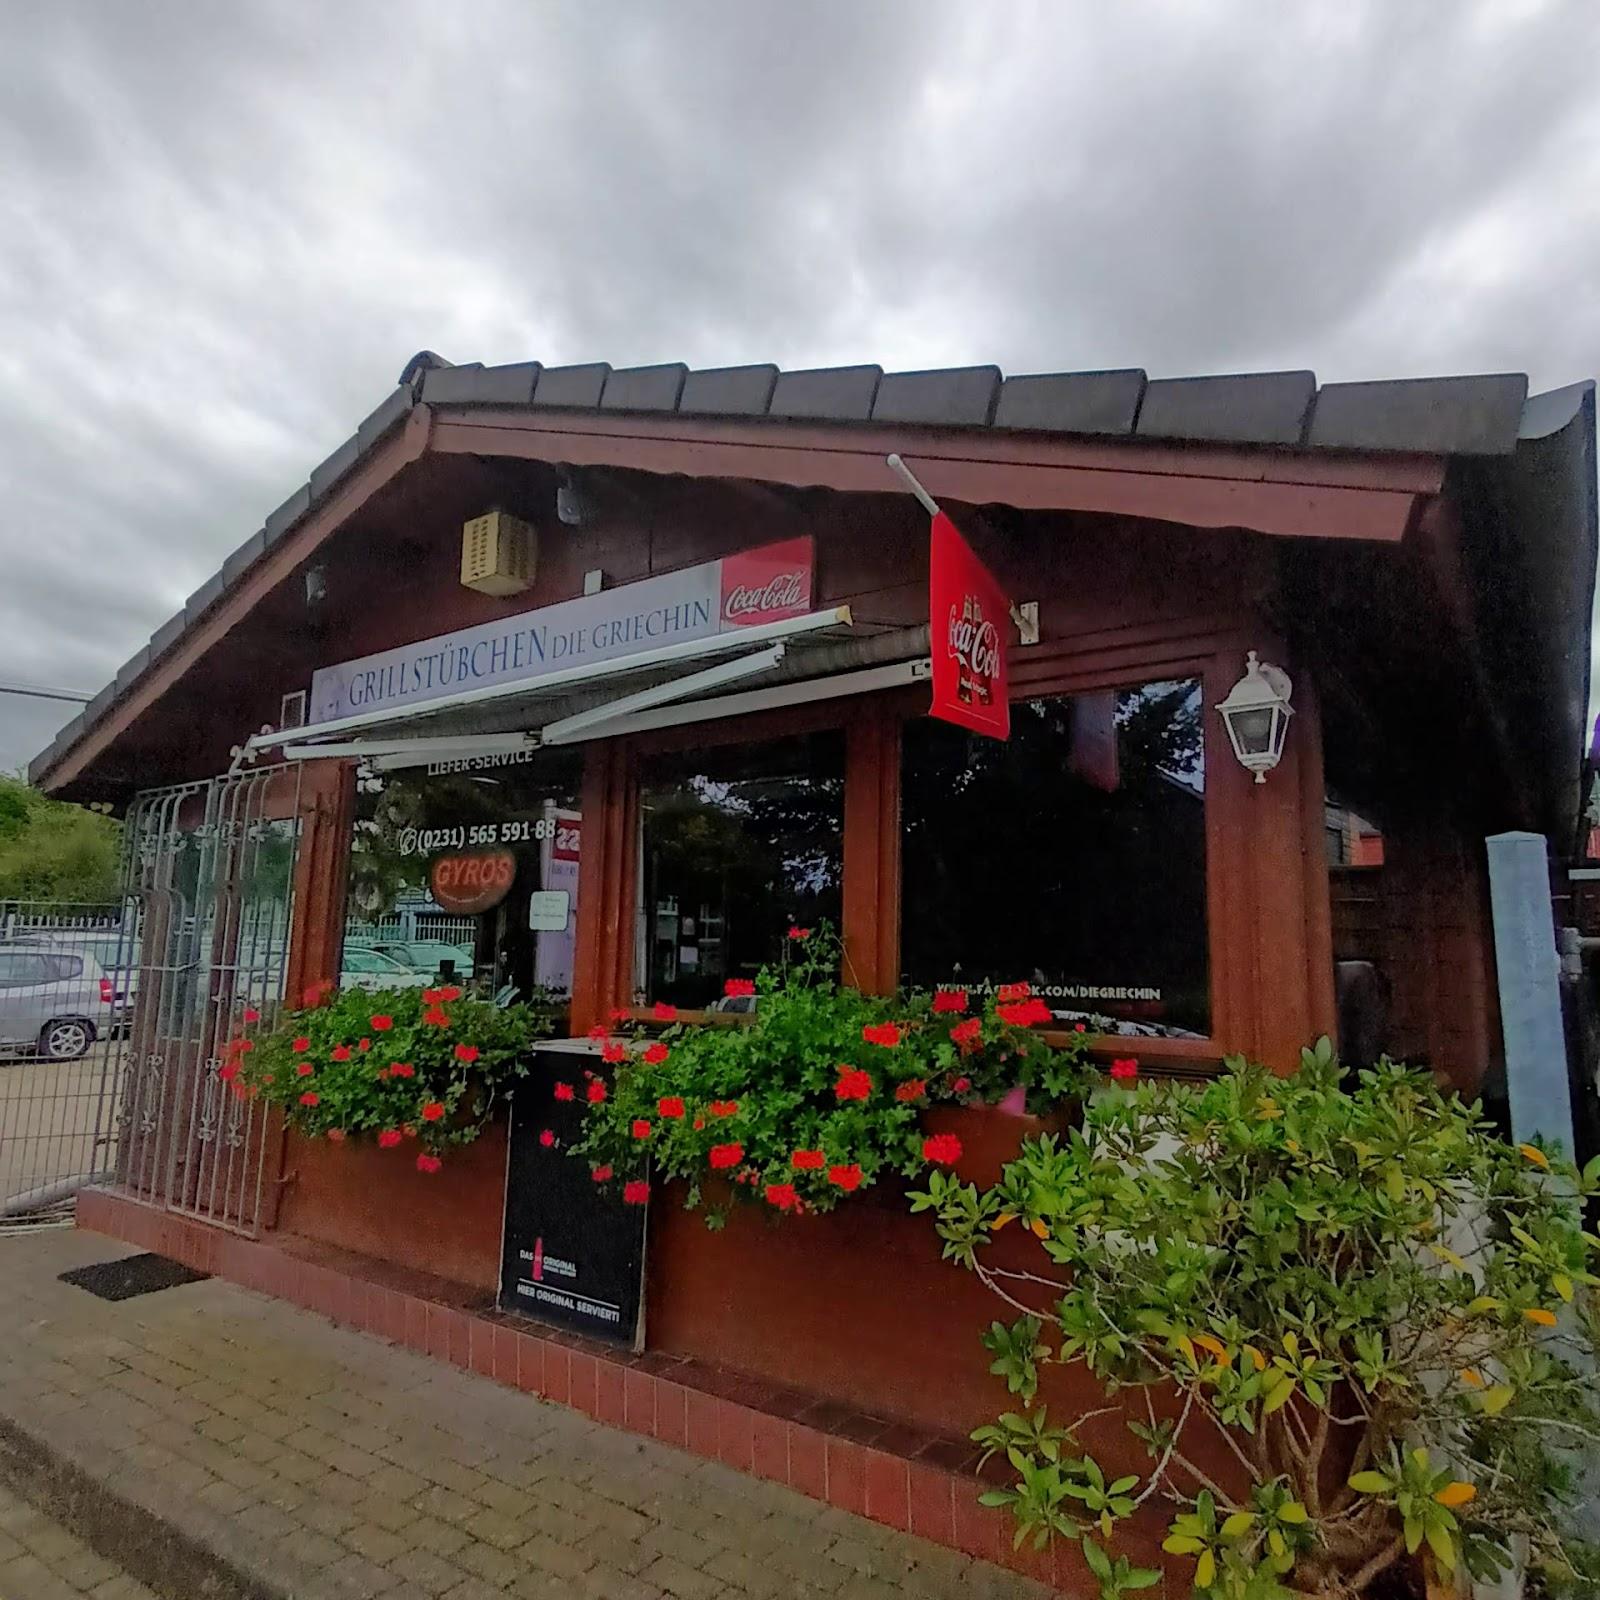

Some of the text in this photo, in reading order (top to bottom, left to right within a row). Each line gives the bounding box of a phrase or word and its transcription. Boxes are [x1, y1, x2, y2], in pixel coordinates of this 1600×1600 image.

[725, 570, 807, 618] Coca-Cola
[349, 599, 711, 706] GRILLSTÜBCHEN DIE GRIECHIN
[428, 750, 533, 776] LIEFER-SERVICE
[418, 819, 556, 849] (0231) 565 591-88
[436, 857, 510, 886] GYROS
[519, 1249, 534, 1261] DAS
[543, 1255, 577, 1273] ORIGINAL
[517, 1284, 535, 1298] HIER
[536, 1289, 575, 1309] ORIGINAL
